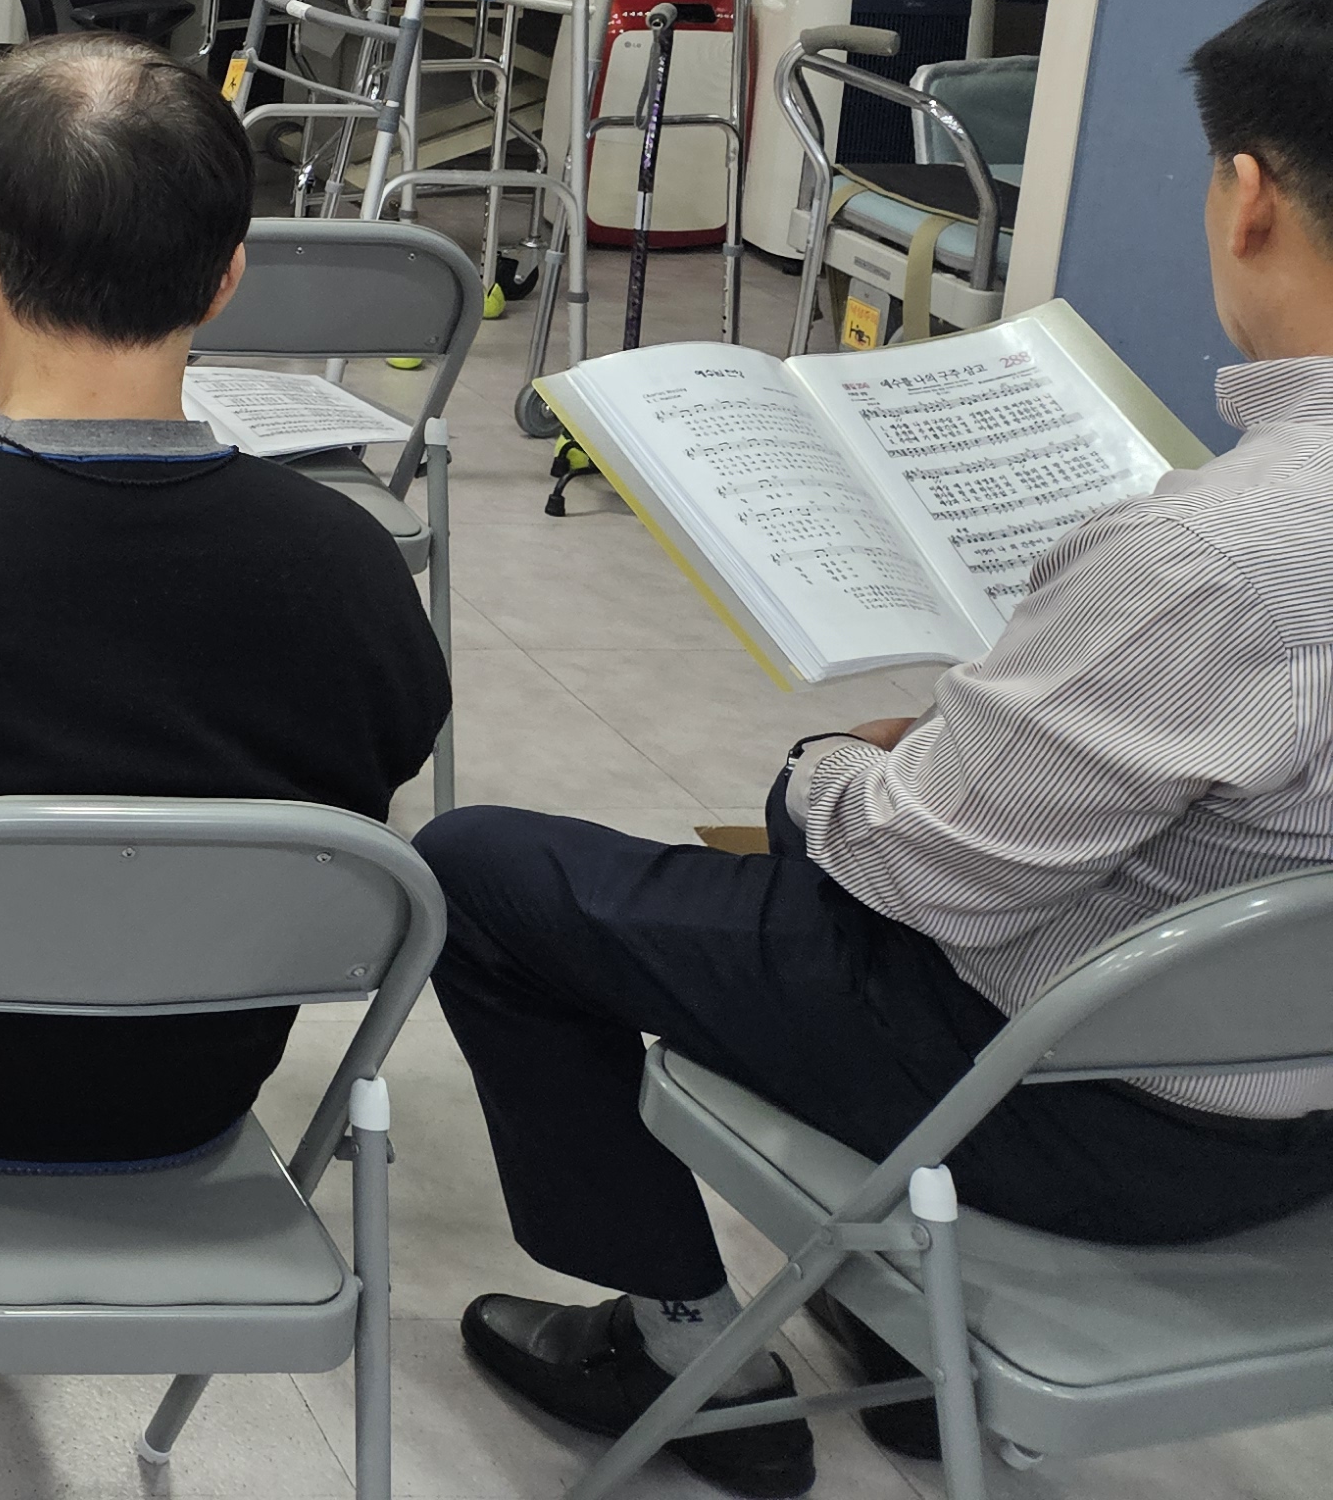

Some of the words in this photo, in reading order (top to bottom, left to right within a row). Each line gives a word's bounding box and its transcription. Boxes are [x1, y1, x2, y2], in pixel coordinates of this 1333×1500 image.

[1000, 351, 1032, 369] 288
[880, 376, 913, 389] 예수를
[913, 371, 938, 384] 나의
[938, 368, 961, 380] 구주
[963, 364, 988, 376] 삼고
